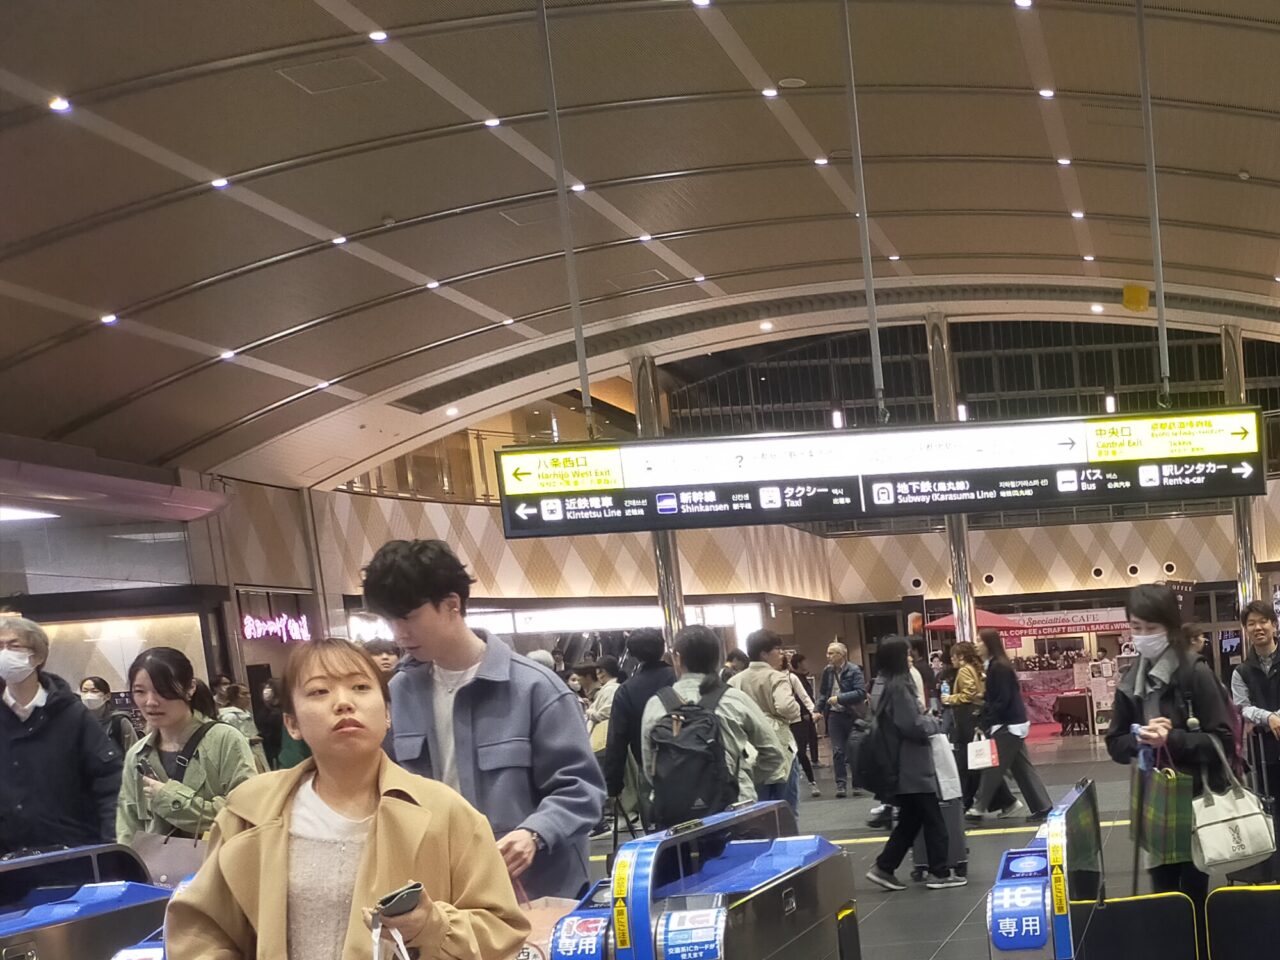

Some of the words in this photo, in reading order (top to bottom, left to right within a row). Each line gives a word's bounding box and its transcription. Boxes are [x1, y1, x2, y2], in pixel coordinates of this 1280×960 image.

[1095, 426, 1131, 438] 中央口
[538, 456, 588, 469] 八条西口
[1162, 461, 1228, 476] 駅レンタカー
[1080, 469, 1103, 481] バス
[1163, 475, 1205, 486] Rent-a-car
[783, 485, 829, 498] タクシー
[1081, 481, 1097, 491] Bus
[565, 496, 614, 510] 近鉄電車
[679, 490, 717, 504] 新幹線
[784, 498, 803, 508] Taxi
[897, 494, 931, 504] Subway
[931, 491, 975, 502] (Karasuma
[976, 489, 997, 499] Line)
[566, 509, 603, 520] Kintetsu
[603, 507, 622, 518] Line
[681, 503, 730, 514] Shinkansen
[1026, 616, 1070, 627] Specialties
[1071, 613, 1100, 624] CAFE
[1009, 628, 1038, 637] COFFEE
[1042, 626, 1066, 635] CRAFT
[1067, 625, 1086, 633] BEER
[1090, 623, 1110, 631] SAKE
[997, 916, 1041, 938] 専用
[557, 936, 597, 957] 専用
